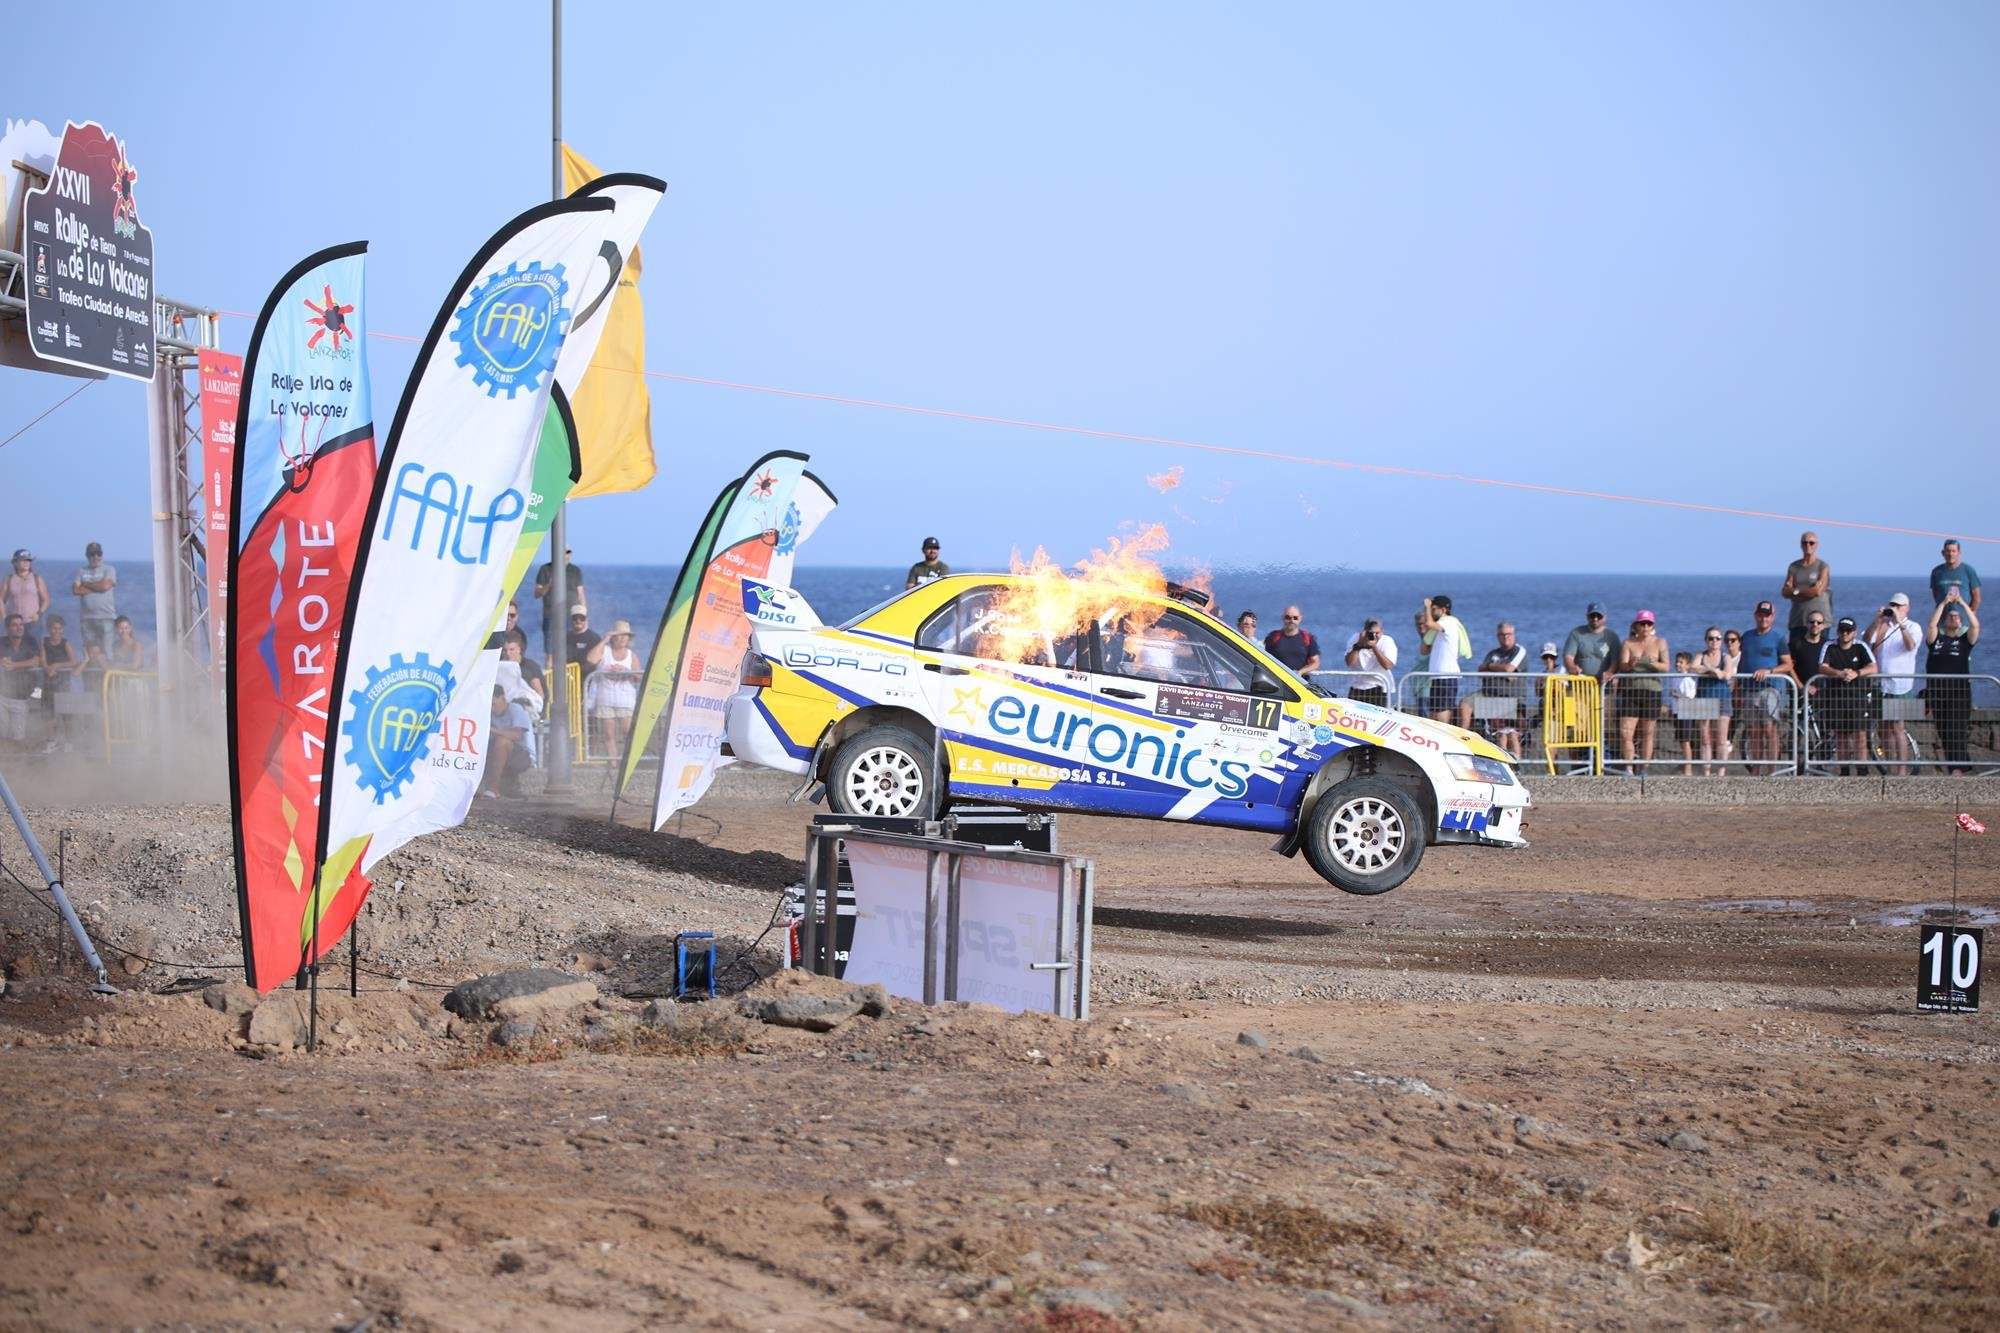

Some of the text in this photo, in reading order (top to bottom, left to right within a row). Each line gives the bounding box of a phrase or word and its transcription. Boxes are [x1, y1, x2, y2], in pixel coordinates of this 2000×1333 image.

[56, 165, 90, 206] XXVII
[55, 207, 90, 253] Rallye
[91, 235, 99, 251] de
[69, 249, 84, 281] de
[87, 252, 105, 287] Los
[108, 258, 149, 301] Volcanes
[58, 287, 149, 326] Trofeo Ciudad de Arrecife
[204, 377, 240, 397] LANZAROTE
[310, 375, 334, 391] Isla
[339, 376, 353, 393] de
[291, 401, 349, 418] Volcanes
[1181, 700, 1223, 710] LANZAROTE
[1255, 700, 1277, 728] 17
[1325, 708, 1368, 732] Son
[674, 732, 720, 752] sports
[987, 695, 1250, 799] euronics
[1399, 726, 1440, 751] Son
[454, 756, 478, 771] Car
[991, 760, 1092, 784] MERCASOSA
[1096, 771, 1126, 787] S.L.
[1923, 931, 1979, 989] 10
